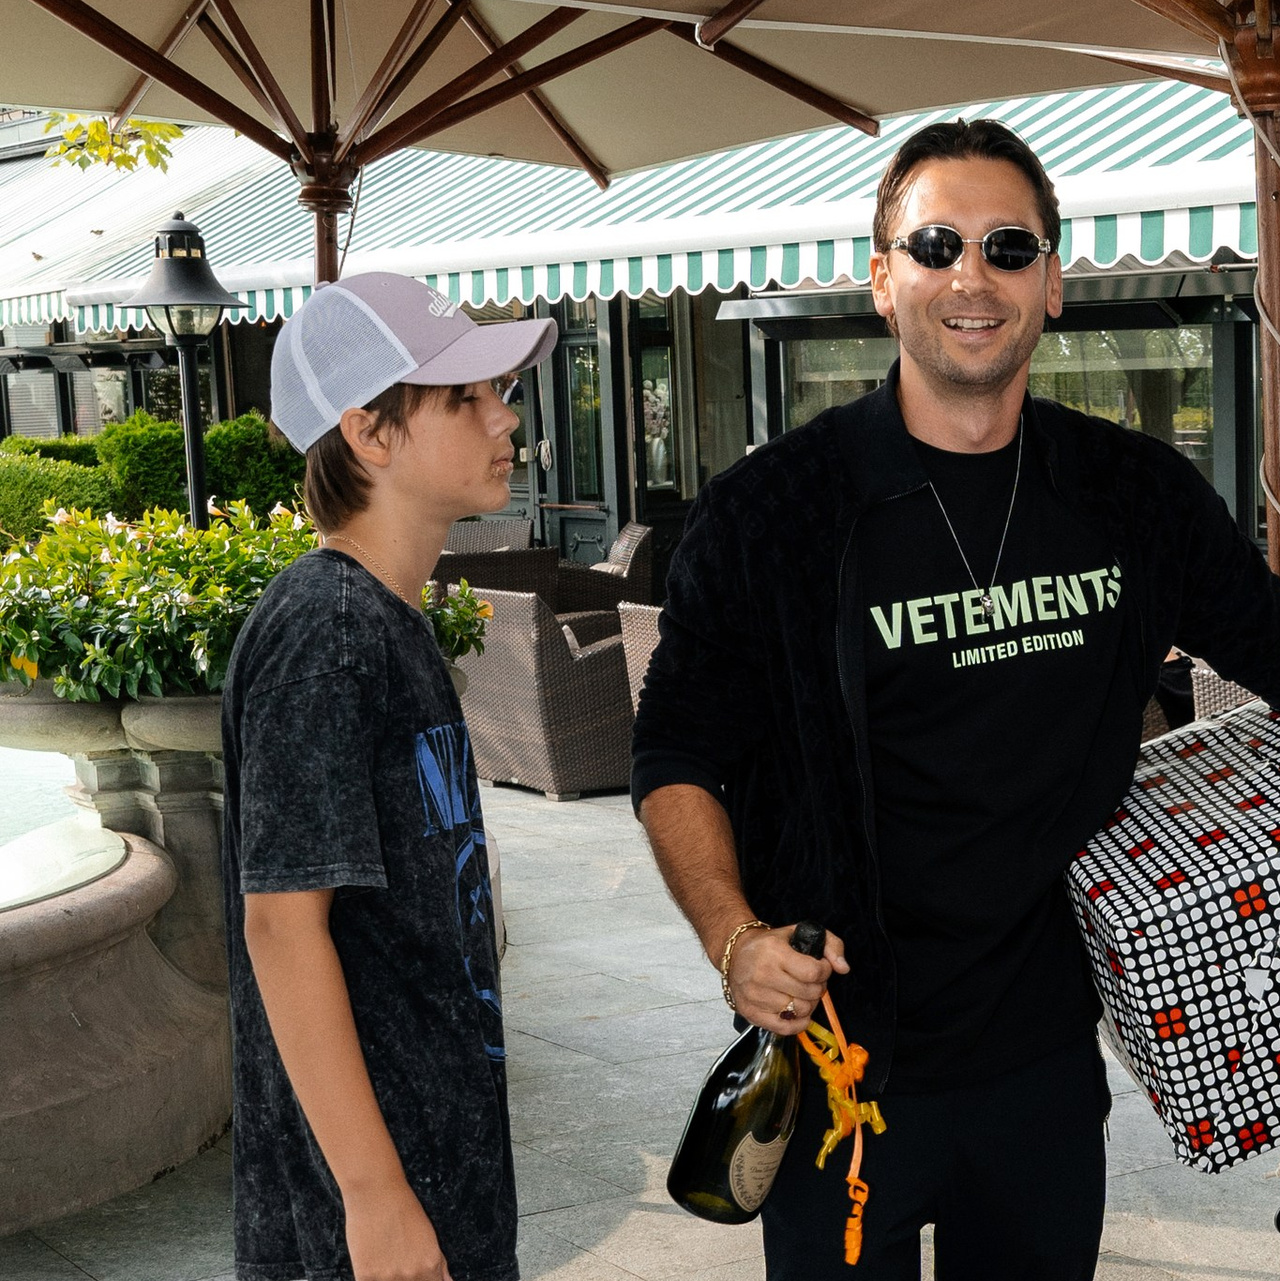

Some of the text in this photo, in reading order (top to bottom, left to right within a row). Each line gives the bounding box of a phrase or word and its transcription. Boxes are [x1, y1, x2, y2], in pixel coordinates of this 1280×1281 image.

[869, 565, 1122, 650] VETEMENTS
[952, 629, 1085, 669] LIMITED EDITION
